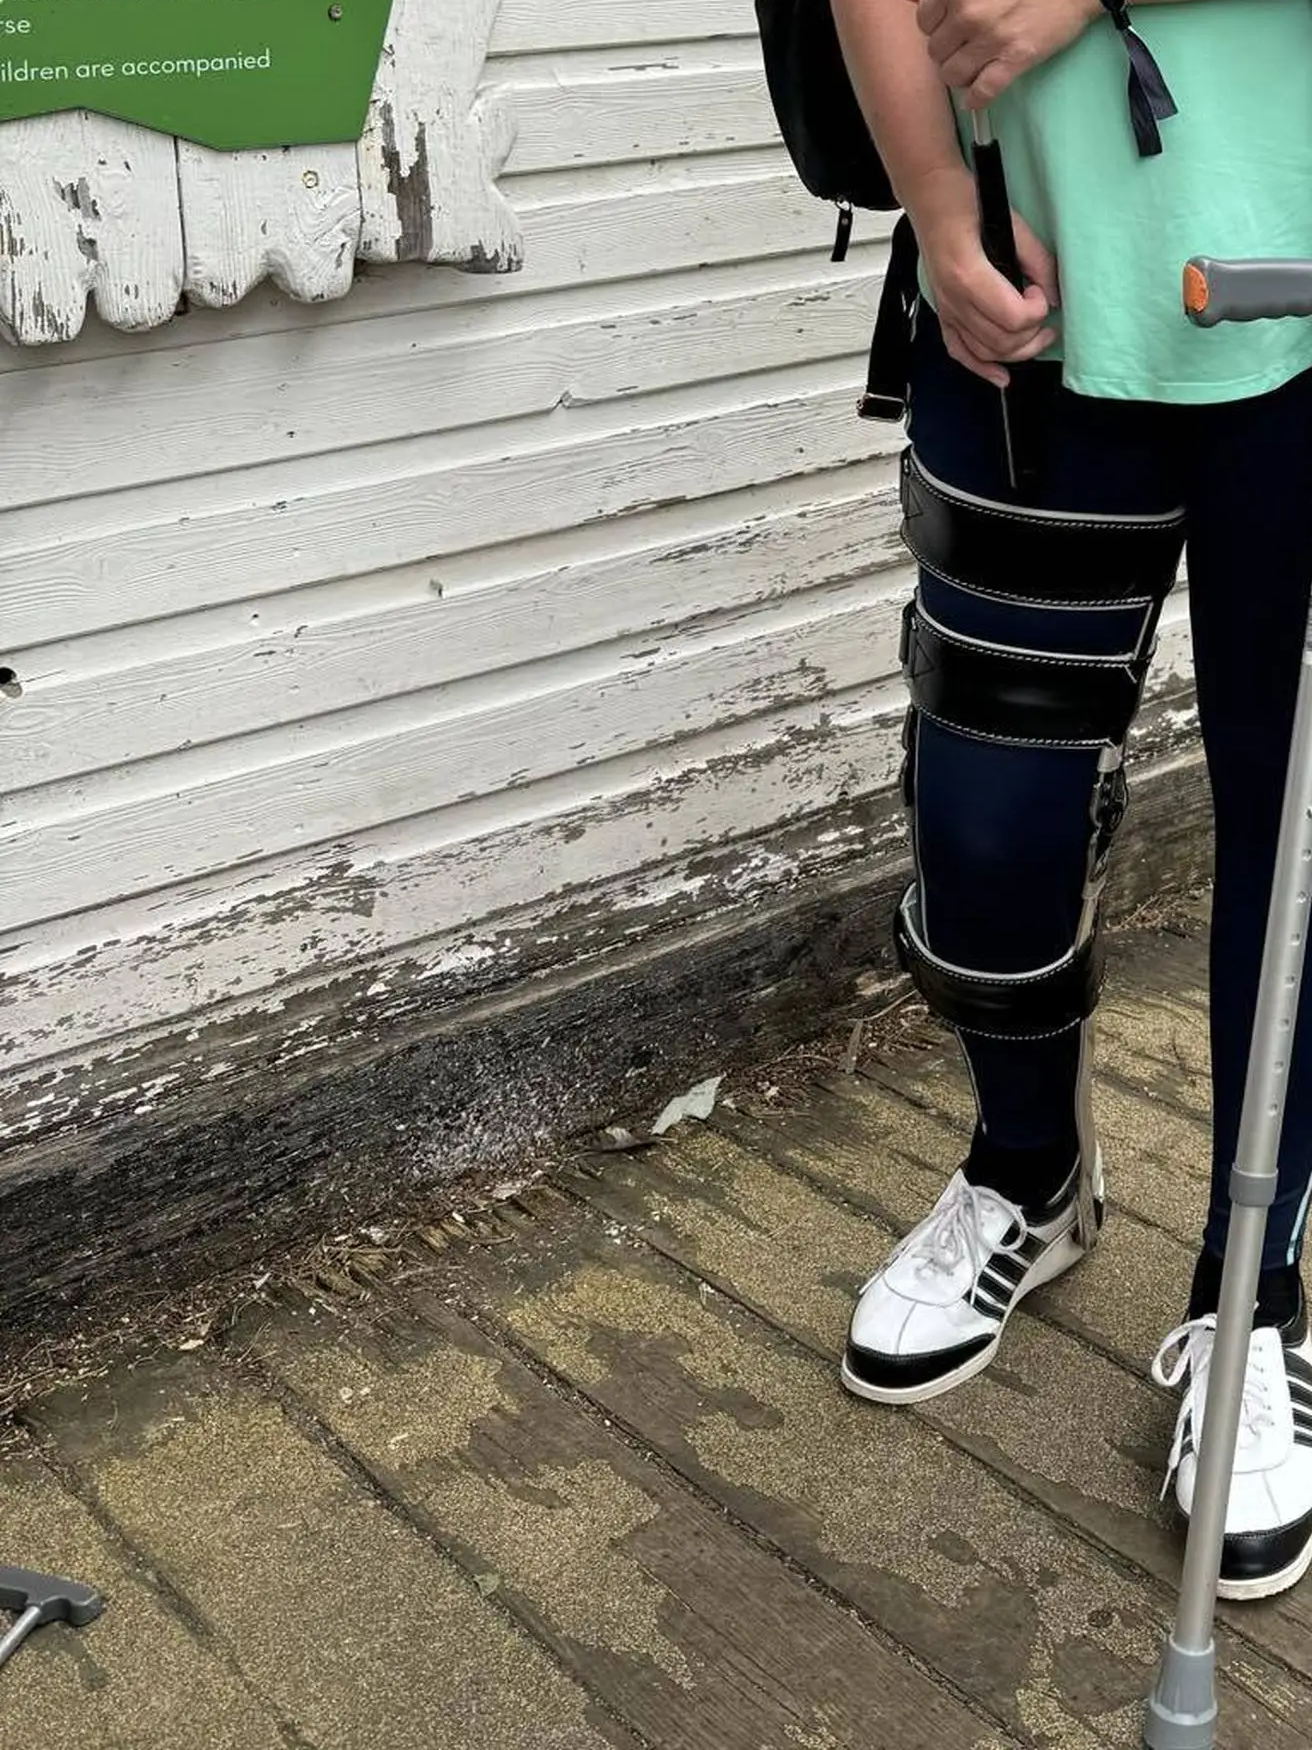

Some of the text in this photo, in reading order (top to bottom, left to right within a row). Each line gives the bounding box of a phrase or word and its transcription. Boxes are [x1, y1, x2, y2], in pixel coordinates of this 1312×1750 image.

[0, 47, 271, 83] ildren are accompanied
